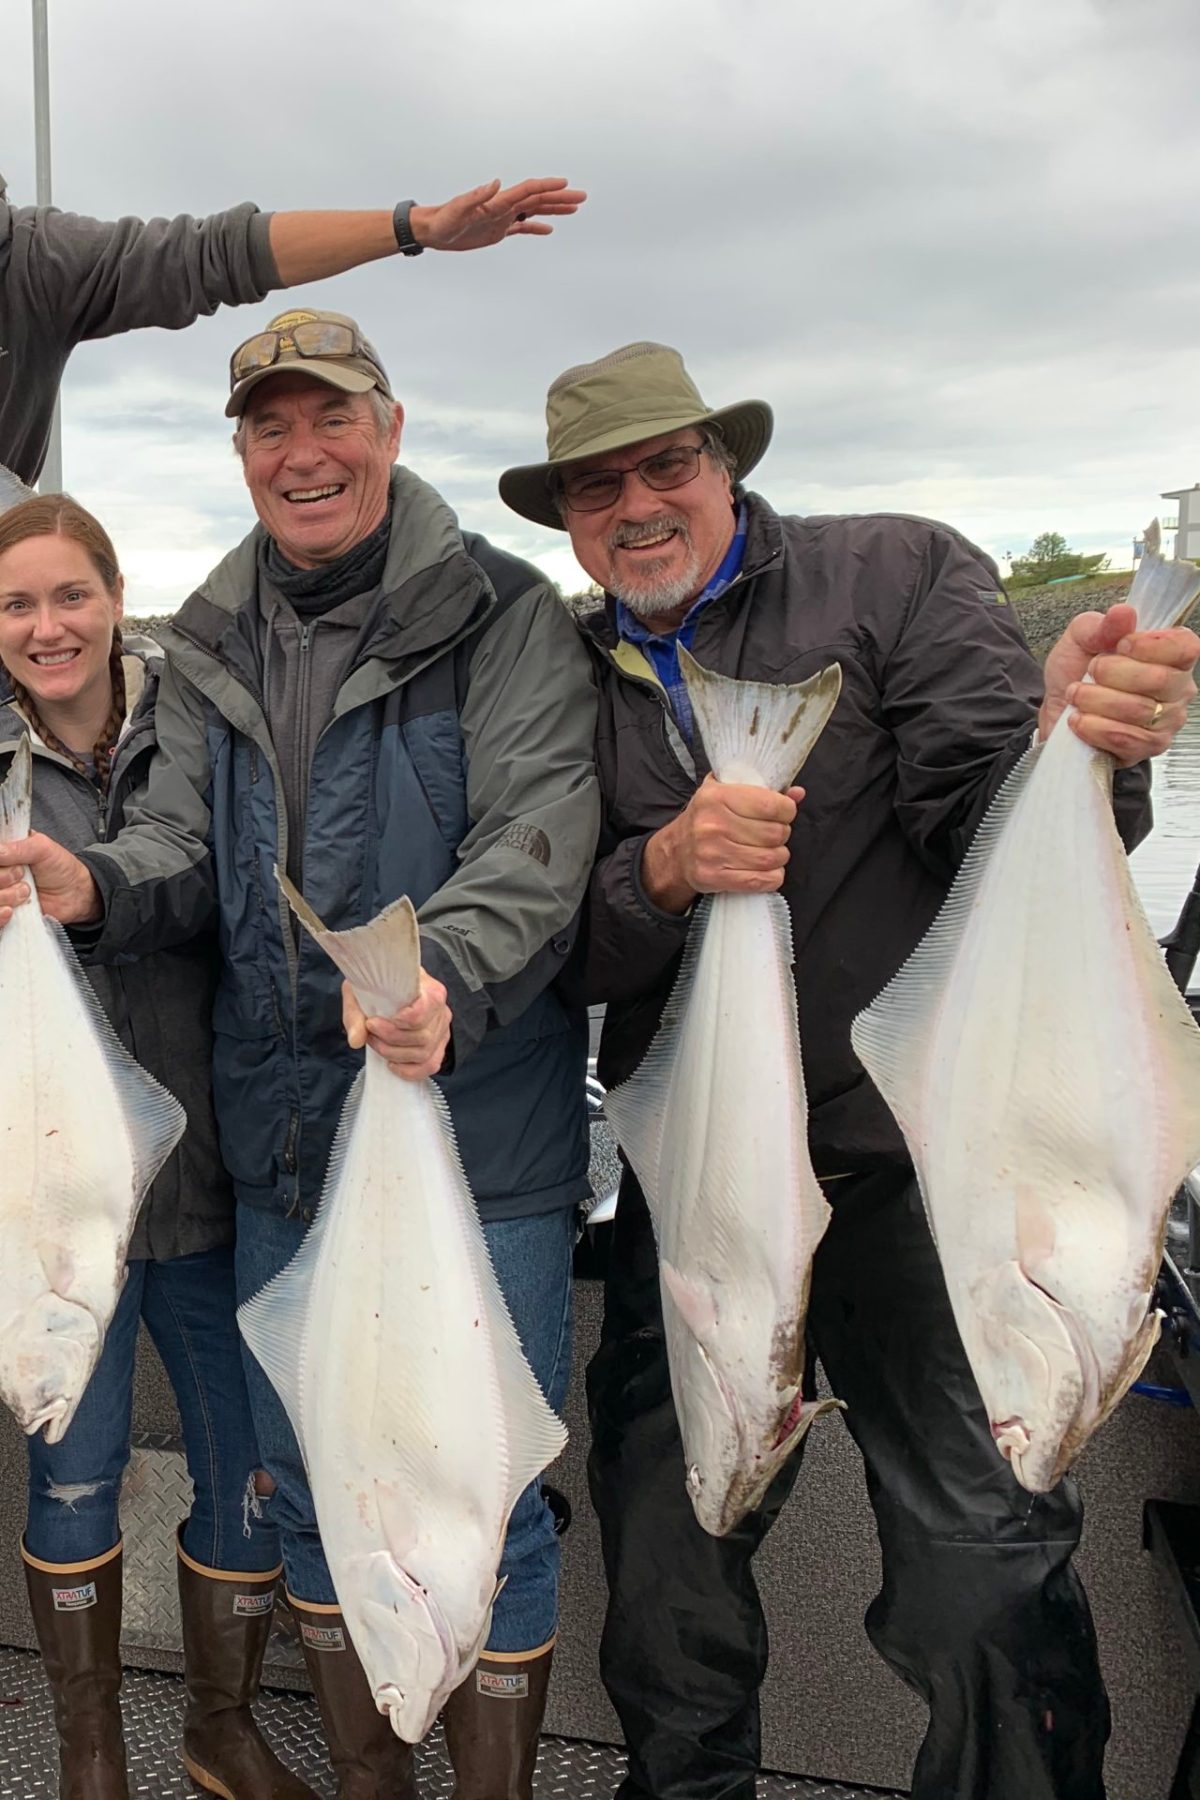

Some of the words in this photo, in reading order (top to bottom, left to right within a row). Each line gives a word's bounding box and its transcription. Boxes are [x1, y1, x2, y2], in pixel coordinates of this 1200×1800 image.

[56, 1587, 91, 1600] XTRATUF
[302, 1627, 339, 1641] XTRATUF
[480, 1673, 523, 1688] XTRATUF
